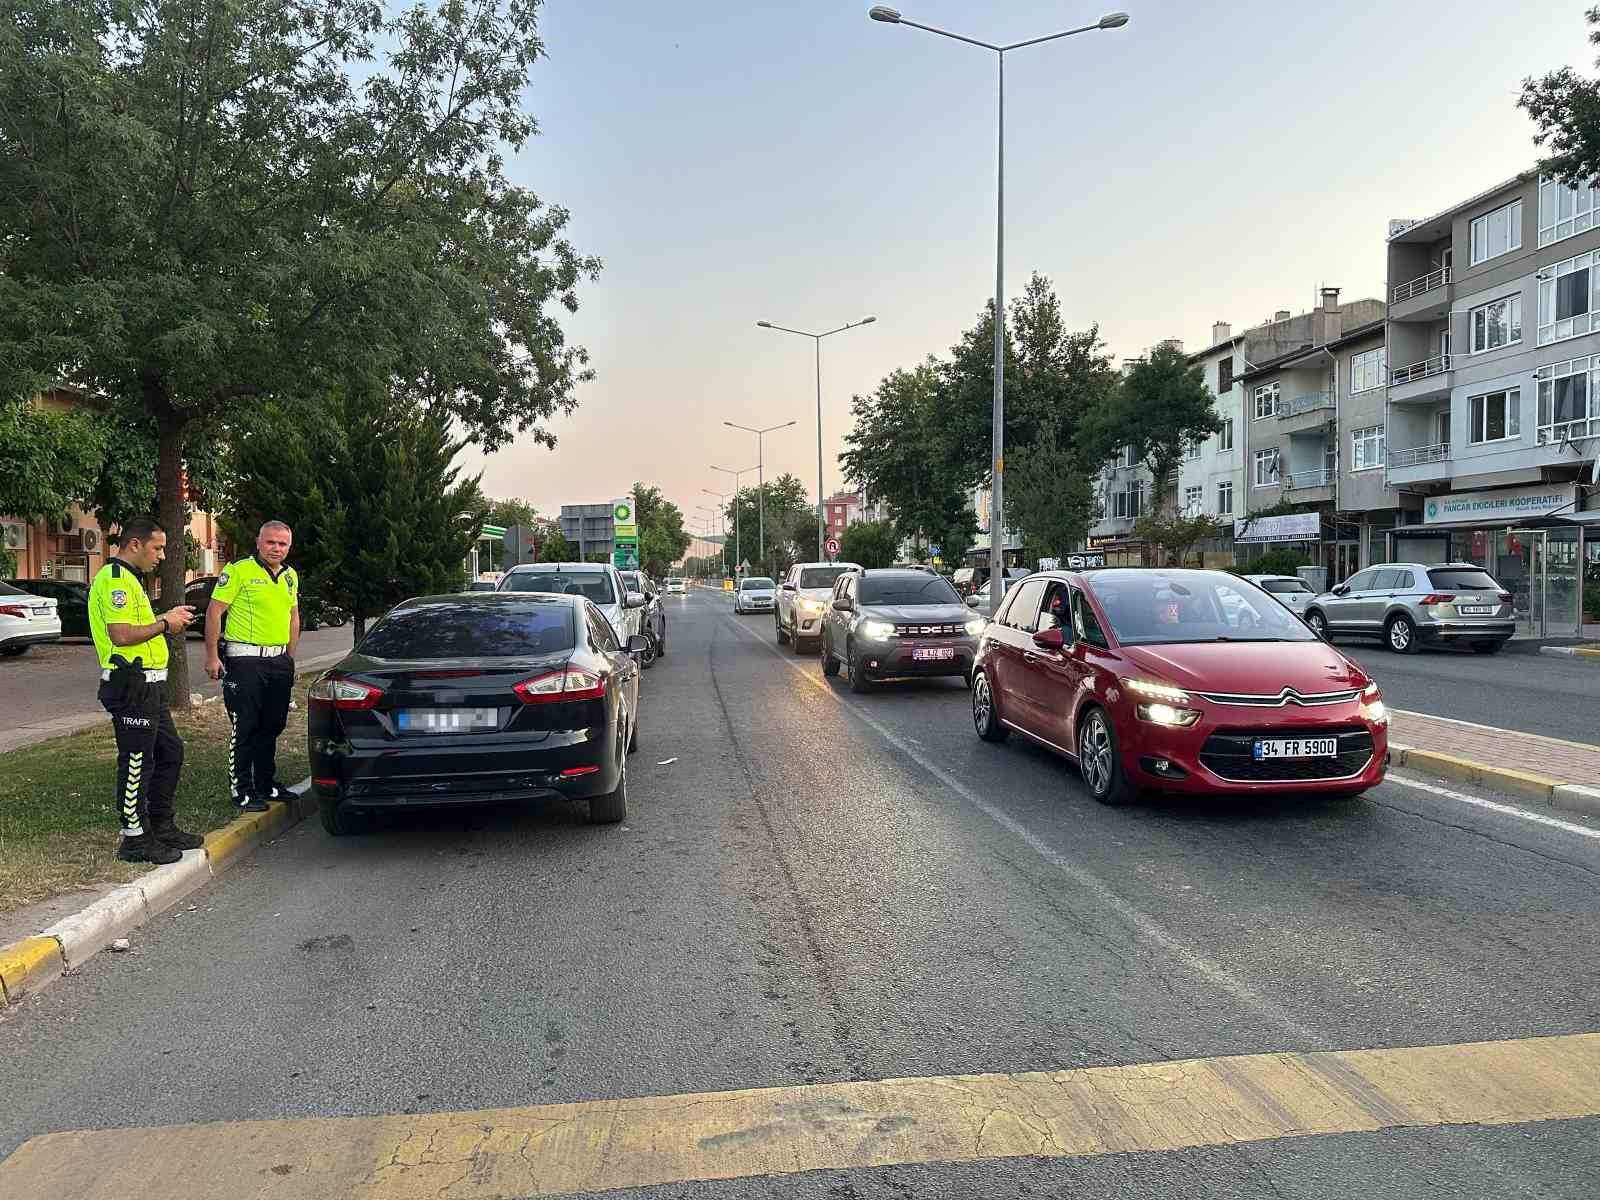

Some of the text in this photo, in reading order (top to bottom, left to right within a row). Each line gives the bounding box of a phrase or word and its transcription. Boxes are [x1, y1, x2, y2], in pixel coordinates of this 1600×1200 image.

[1263, 740, 1334, 756] 34 FR 5900
